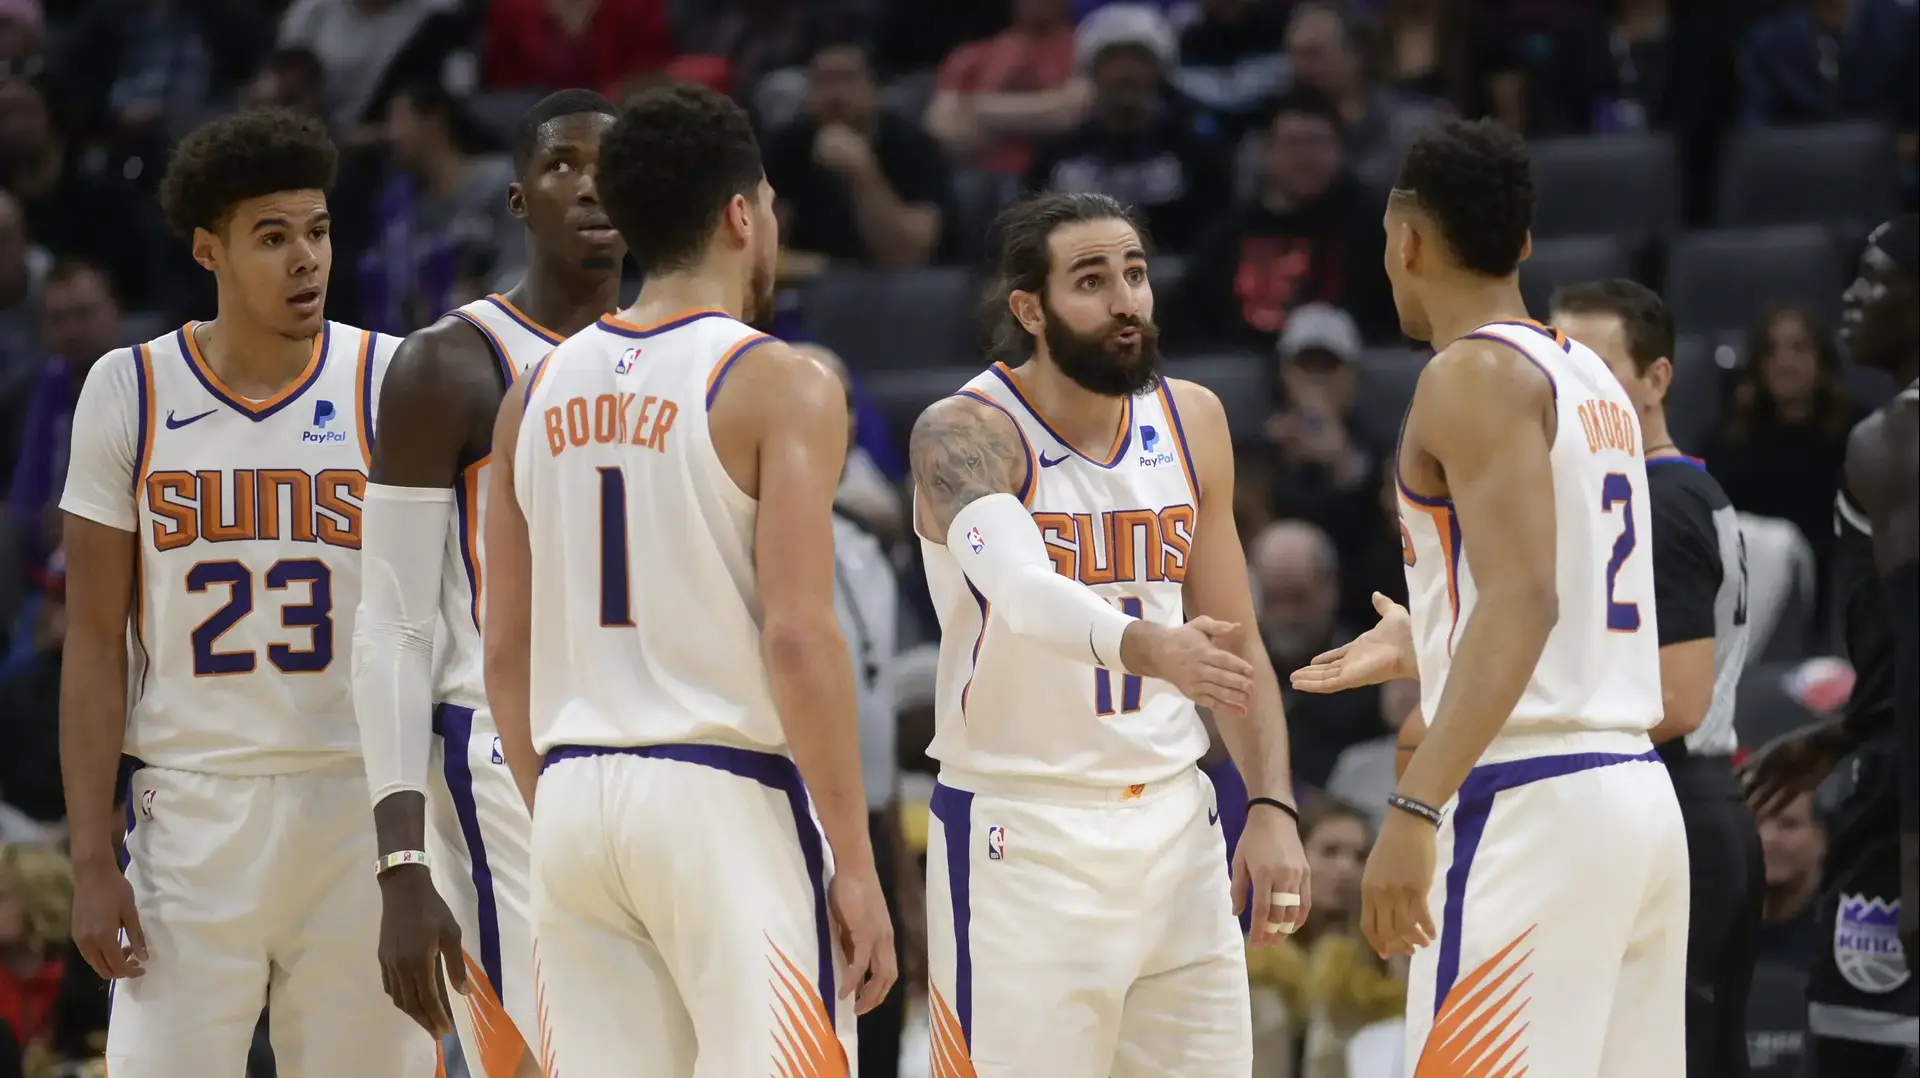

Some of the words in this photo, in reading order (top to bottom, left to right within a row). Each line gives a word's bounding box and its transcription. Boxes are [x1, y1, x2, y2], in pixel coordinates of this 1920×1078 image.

[302, 431, 346, 444] PayPal
[544, 392, 679, 458] BOOKER
[1139, 452, 1174, 468] PayPal
[1577, 399, 1635, 458] OKOBO
[146, 469, 368, 552] SUNS
[595, 466, 637, 628] 1
[1032, 503, 1195, 586] SUNS
[1601, 472, 1642, 633] 2
[185, 557, 334, 678] 23
